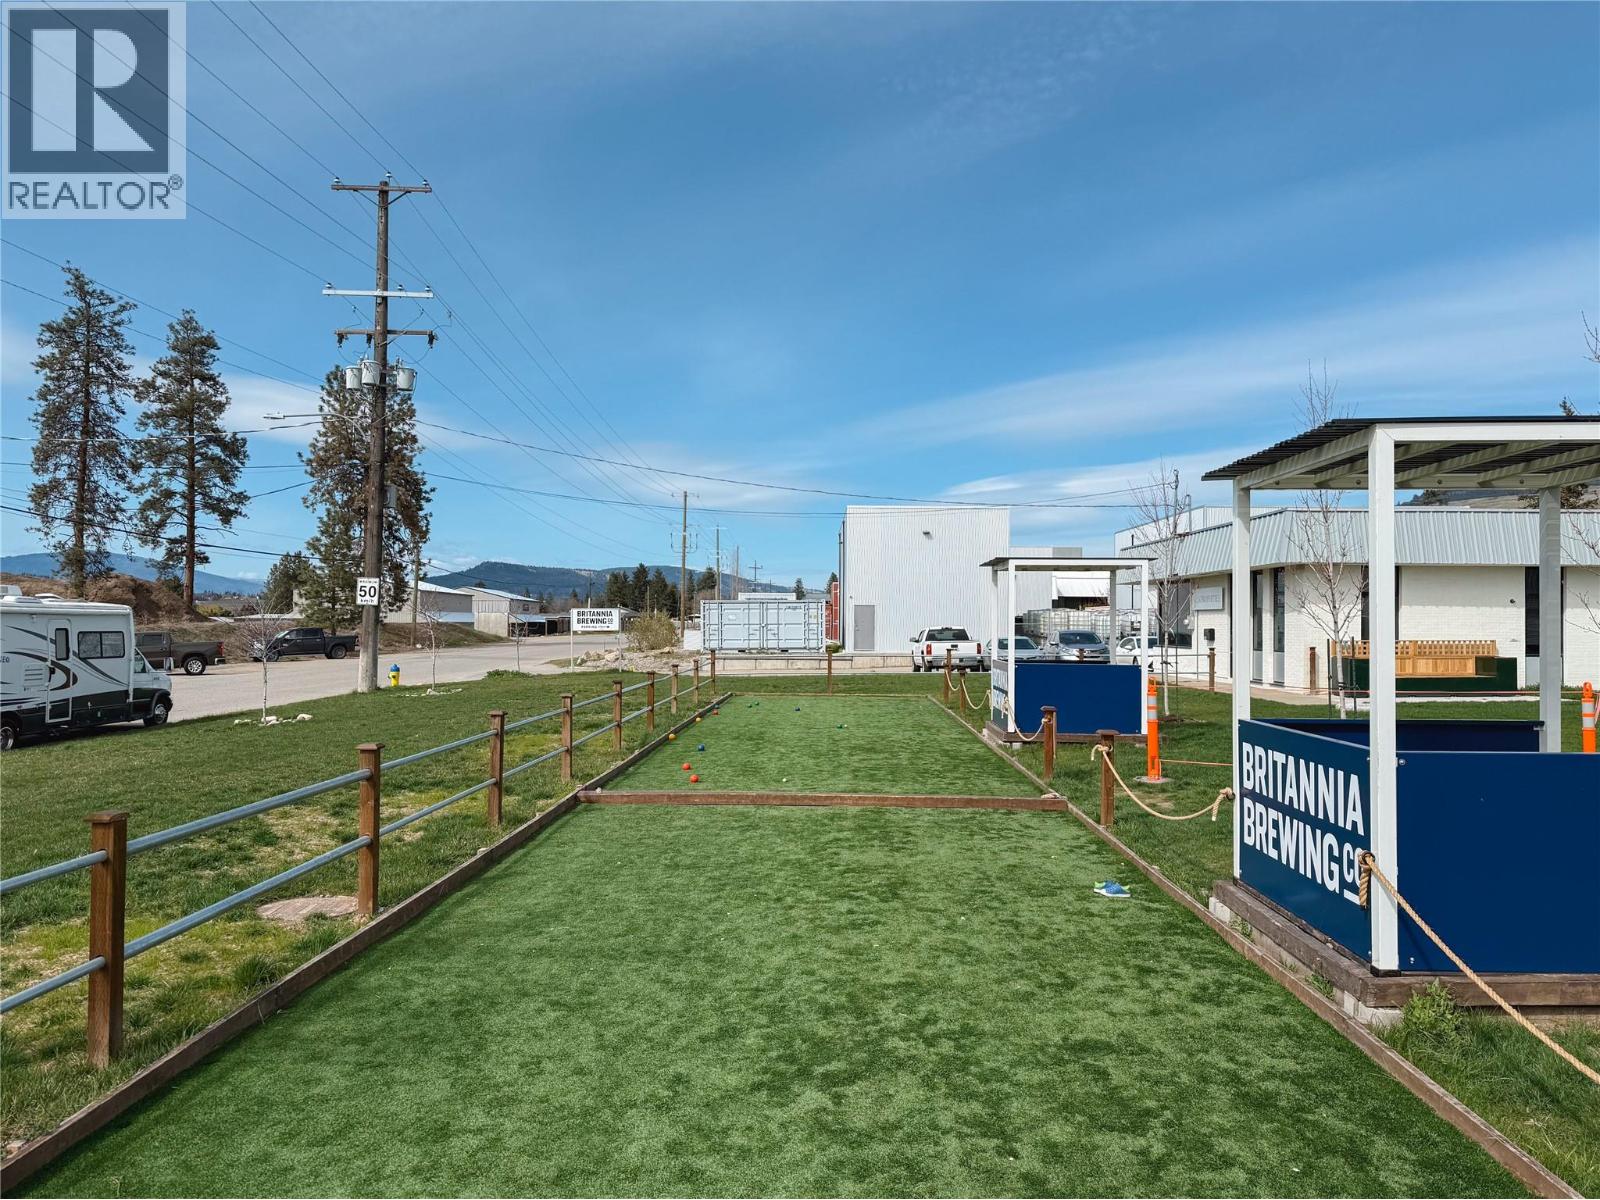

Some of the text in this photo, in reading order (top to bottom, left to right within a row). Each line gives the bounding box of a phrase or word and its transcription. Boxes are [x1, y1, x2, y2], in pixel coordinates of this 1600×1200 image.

[359, 585, 377, 598] 50
[1242, 742, 1365, 836] BRITANNIA
[1243, 797, 1340, 894] BREWING
